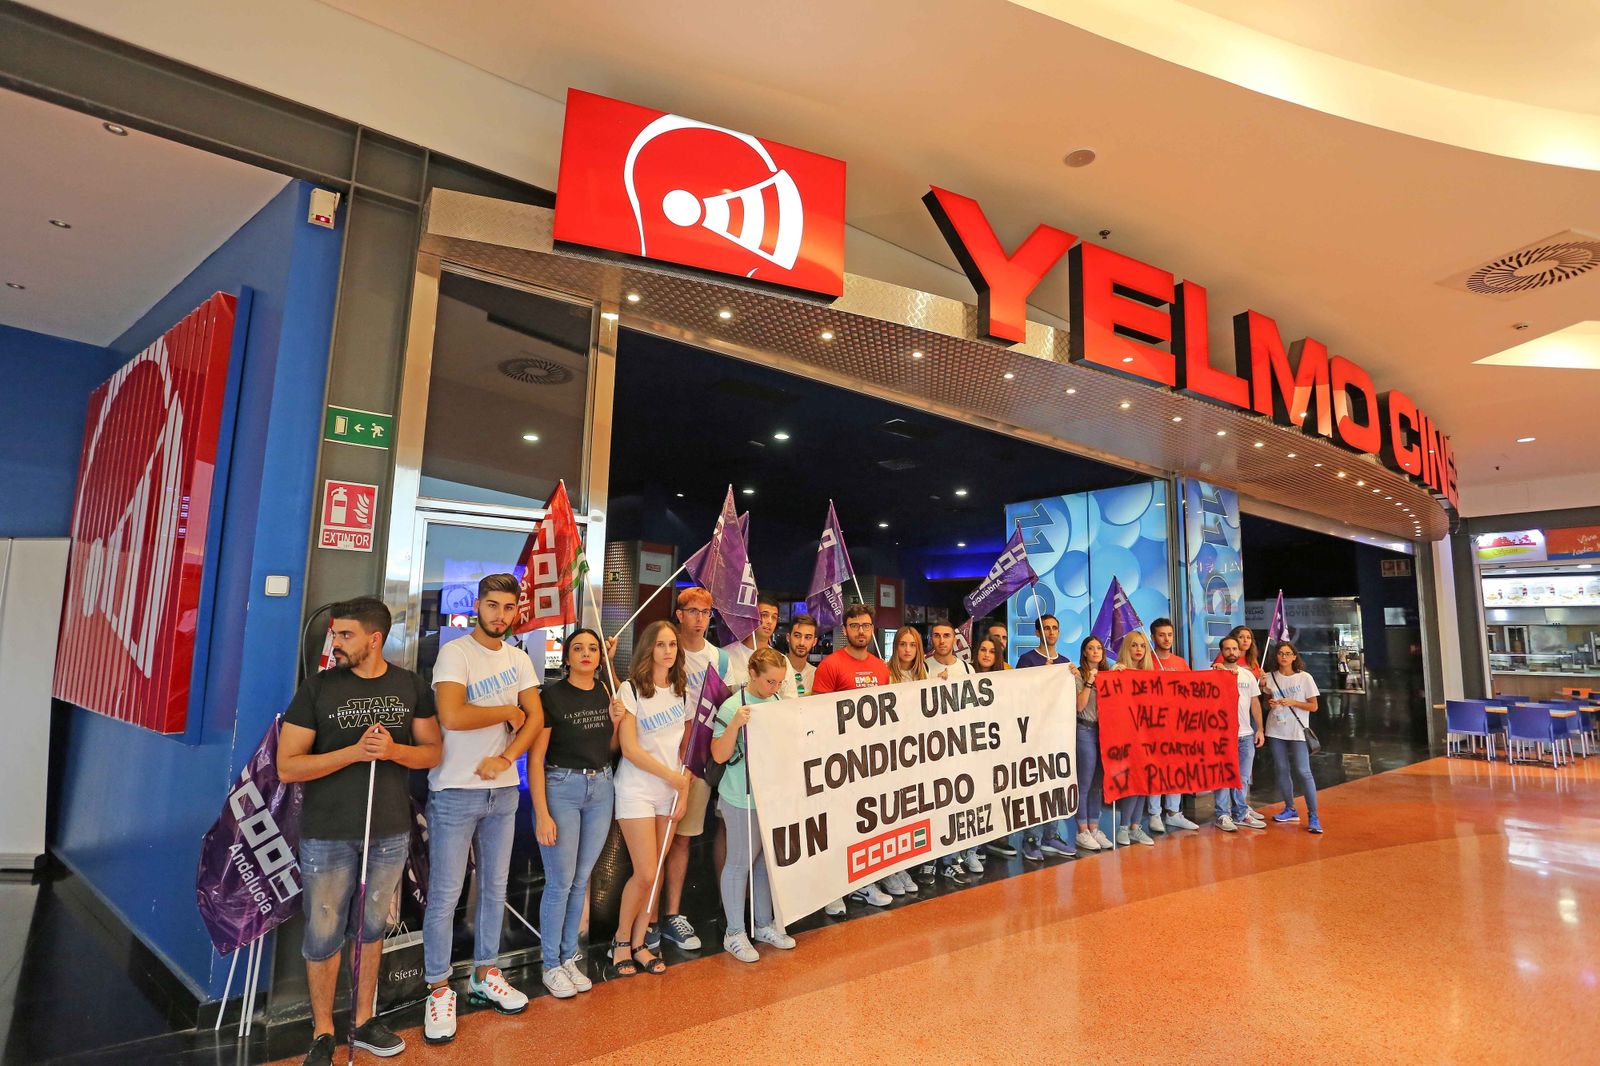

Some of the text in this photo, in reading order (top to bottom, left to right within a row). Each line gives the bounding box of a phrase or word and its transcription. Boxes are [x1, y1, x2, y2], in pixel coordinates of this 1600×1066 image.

[922, 184, 1459, 510] YELMO CINE
[323, 531, 370, 546] EXTINTOR
[823, 588, 842, 616] alucía
[337, 696, 404, 712] STAR
[1168, 680, 1220, 699] TRABAJO
[338, 712, 404, 729] WARS
[836, 678, 994, 735] POR UNAS
[1128, 704, 1228, 733] VALE MENOS
[803, 717, 1029, 797] CONDICIONES Y
[1107, 743, 1131, 760] QUE
[1142, 741, 1156, 755] TU
[1213, 737, 1229, 755] DE
[1144, 758, 1236, 794] PALOMITAS
[772, 752, 1071, 867] UN SUELDO DIGNO
[939, 803, 994, 846] JEREZ
[1001, 784, 1077, 832] YELMO
[228, 842, 273, 916] Andalucía
